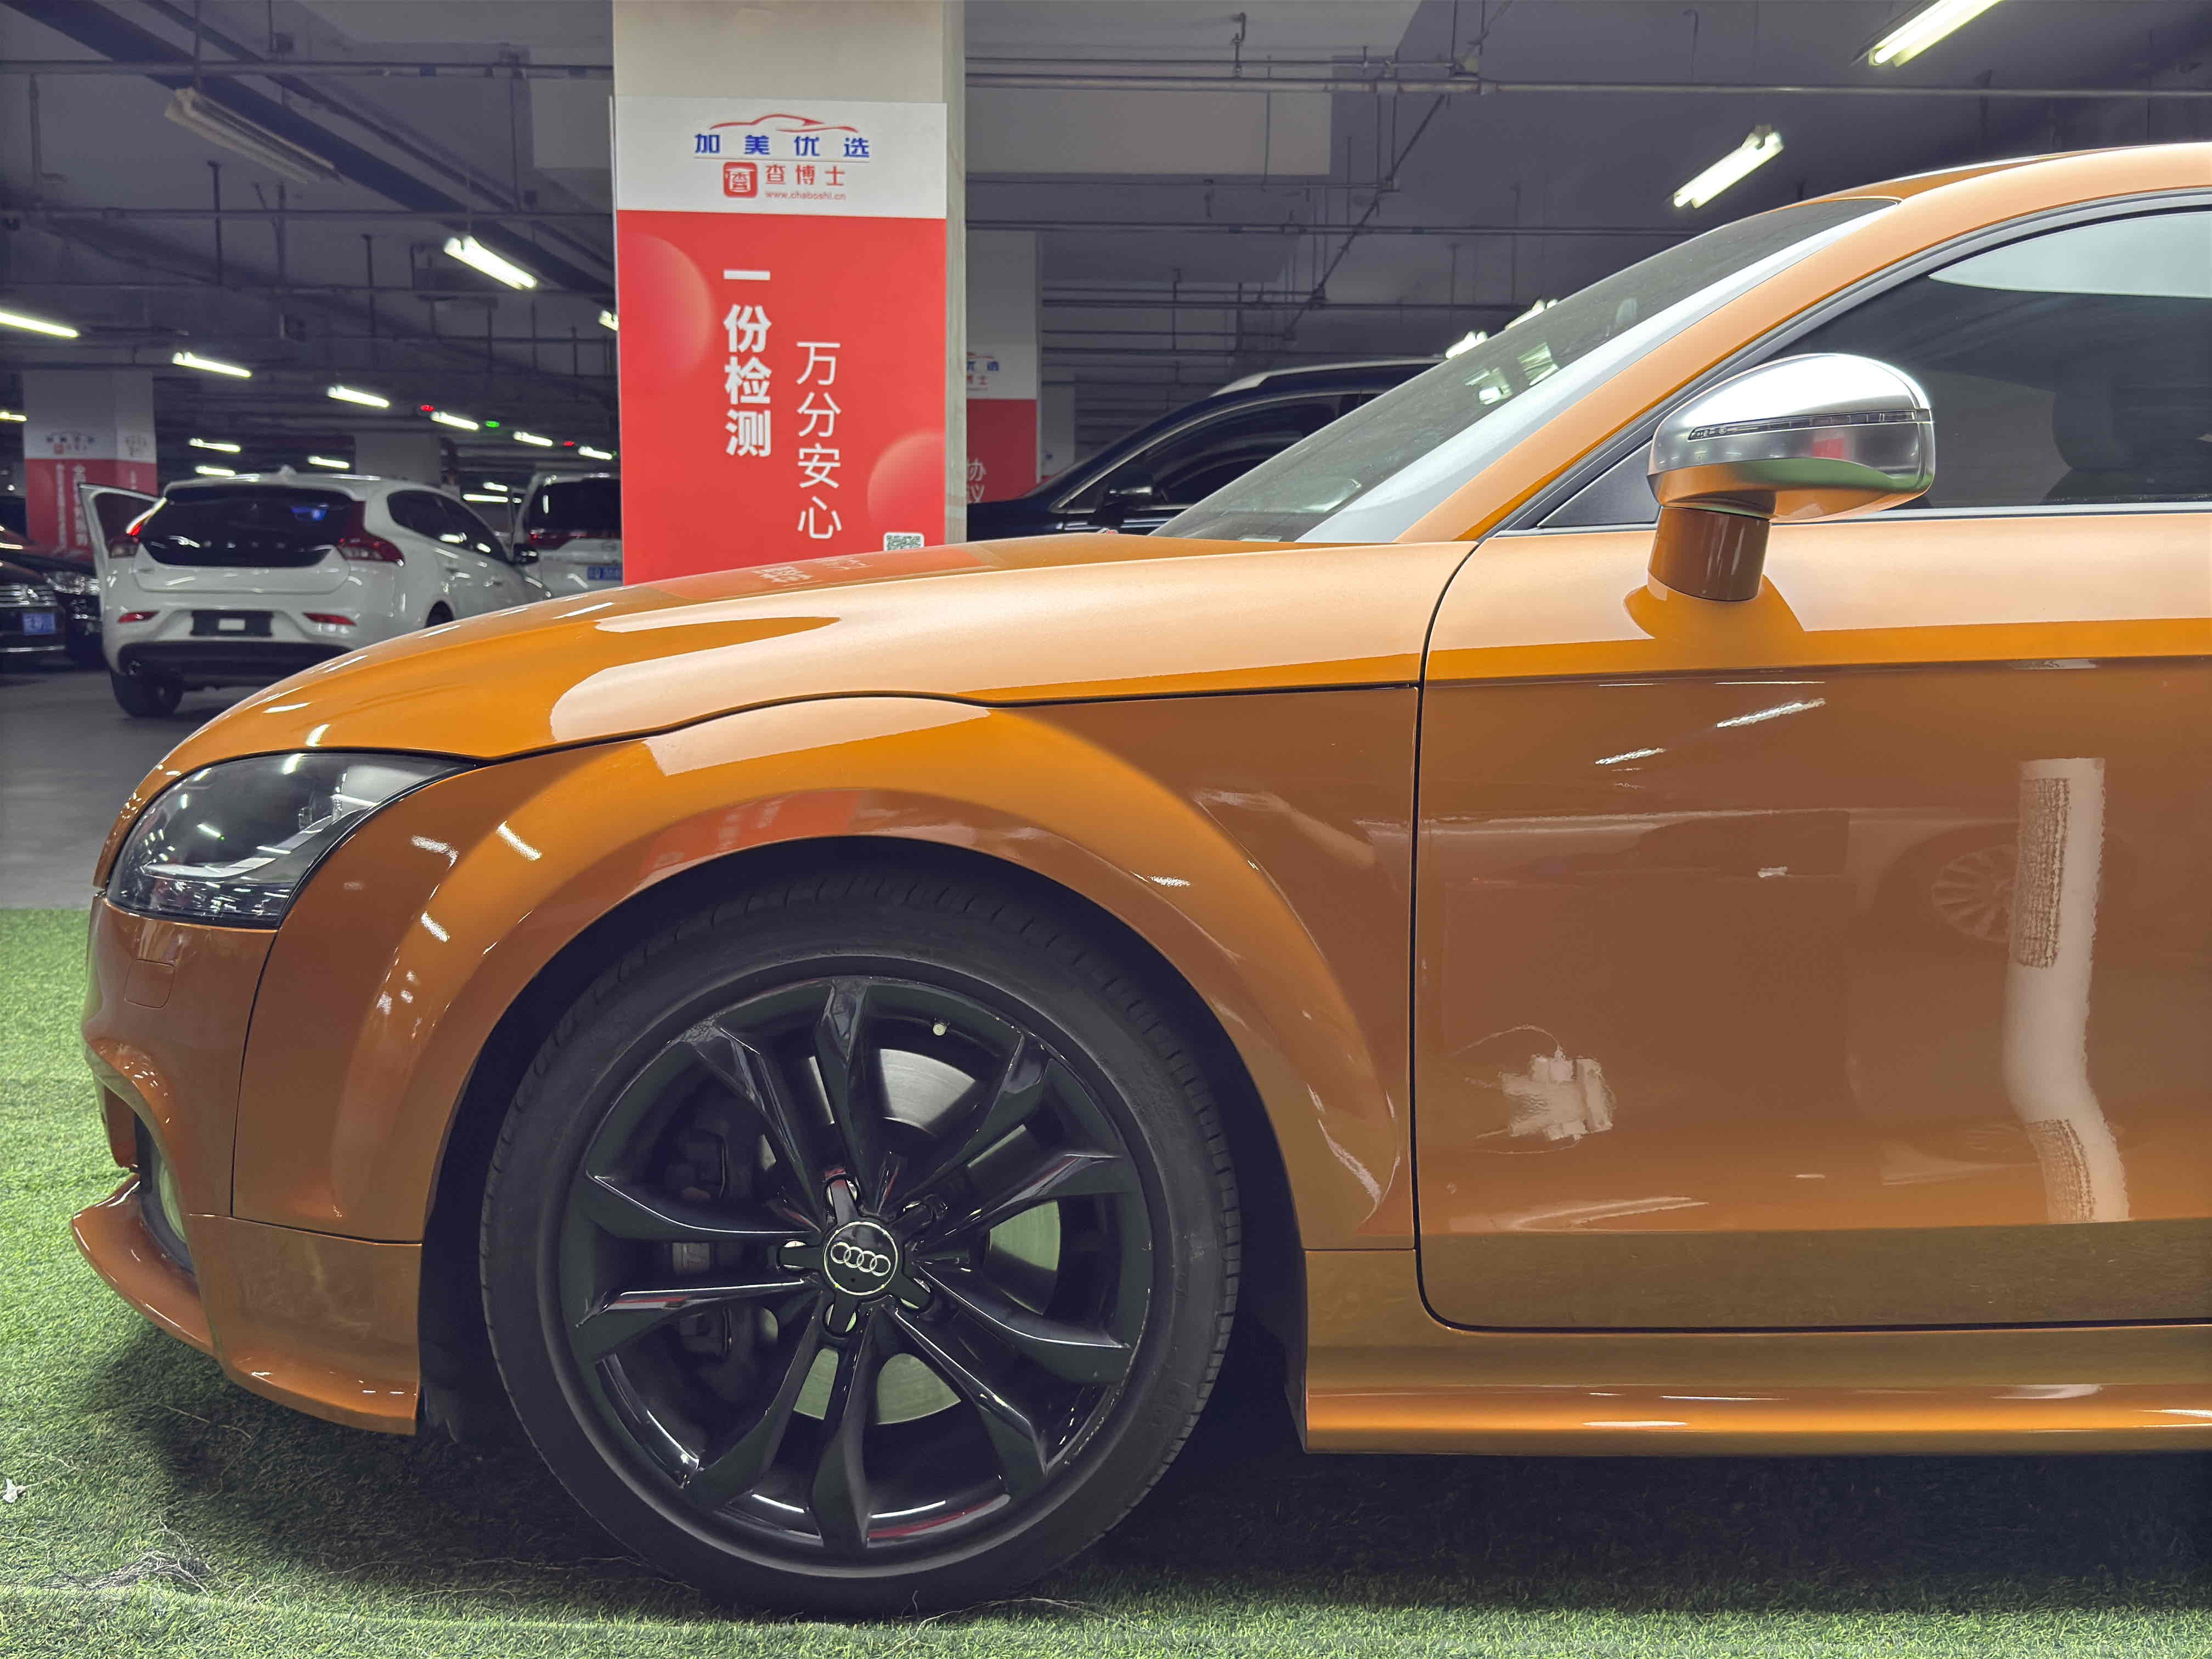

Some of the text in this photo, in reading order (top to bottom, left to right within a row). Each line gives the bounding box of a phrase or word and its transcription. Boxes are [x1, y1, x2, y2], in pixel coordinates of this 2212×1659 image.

[695, 133, 870, 159] 加美优选
[765, 164, 845, 187] 查博士
[723, 269, 772, 458] 一份检测
[796, 341, 843, 540] 万分安心
